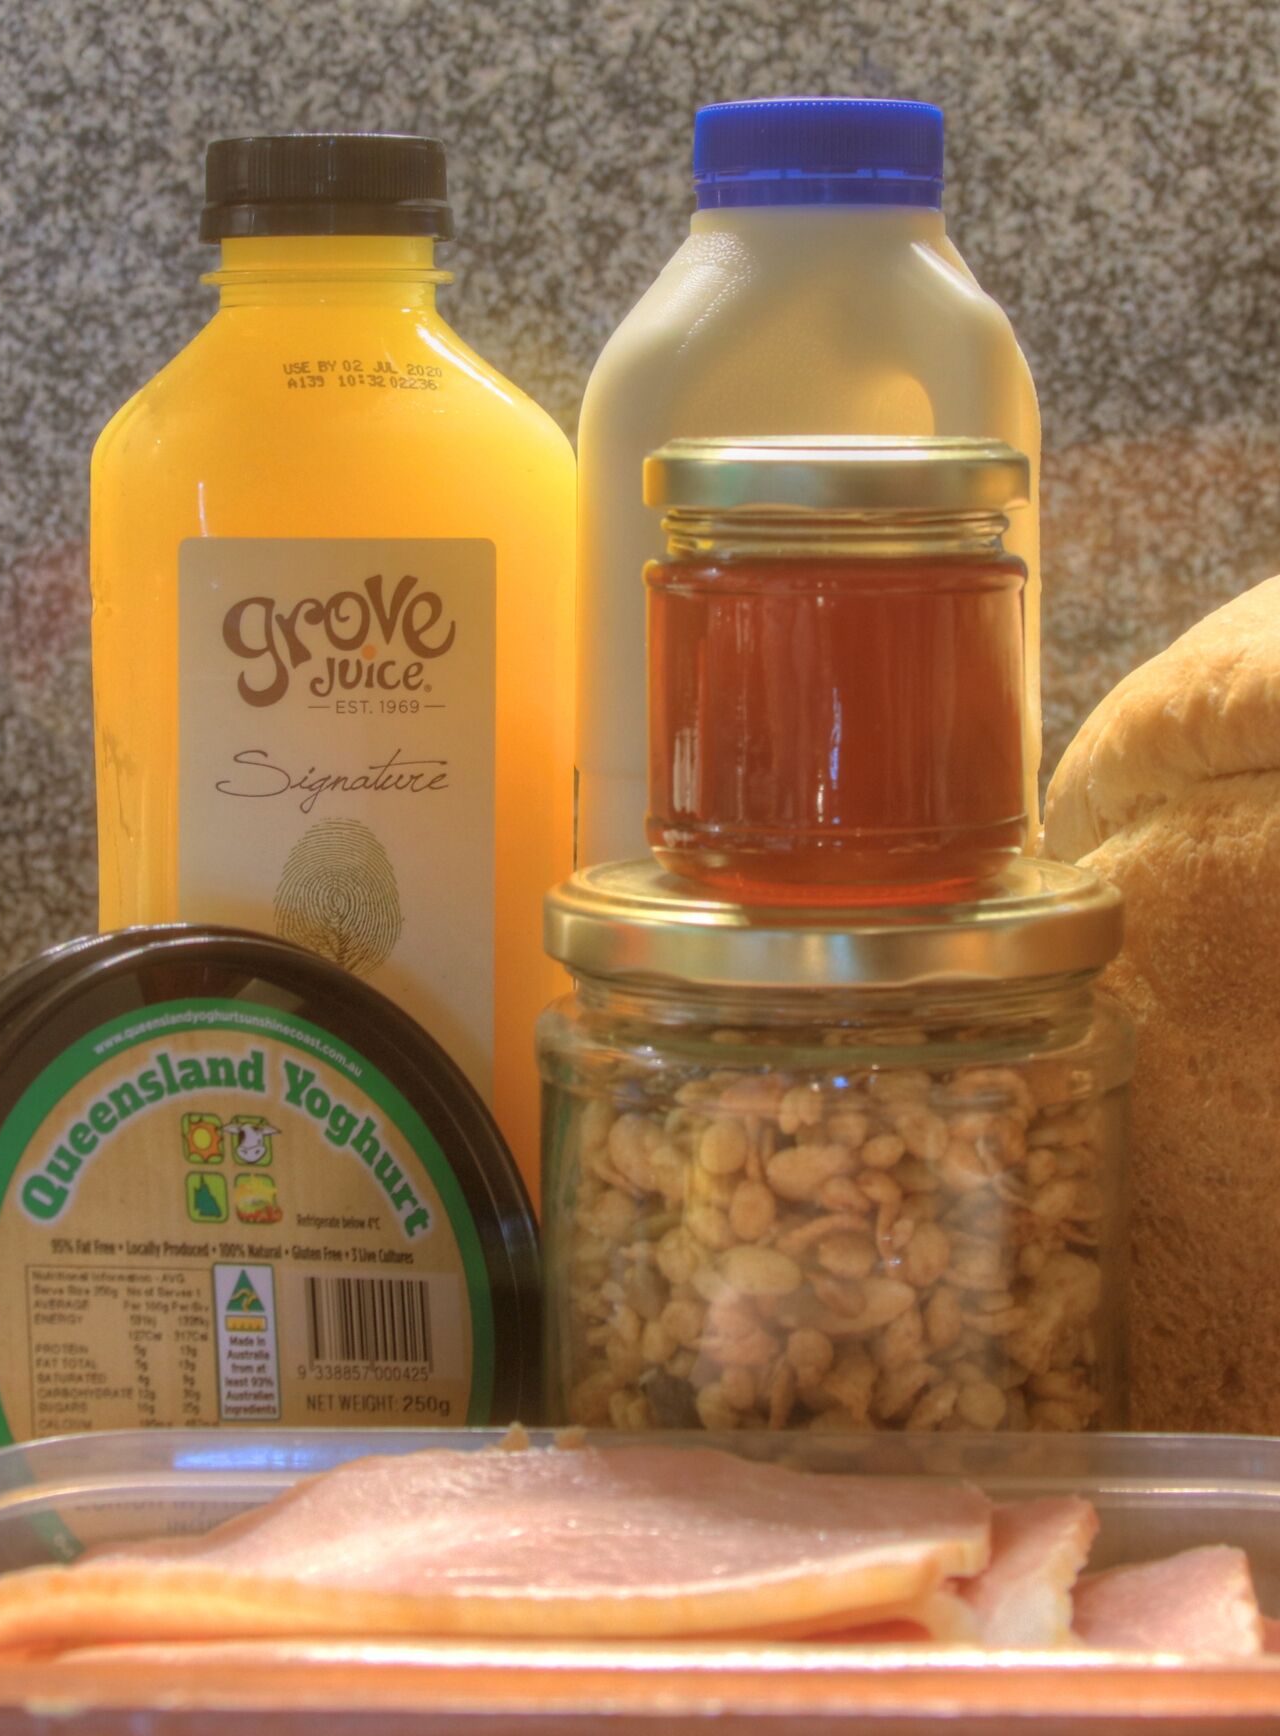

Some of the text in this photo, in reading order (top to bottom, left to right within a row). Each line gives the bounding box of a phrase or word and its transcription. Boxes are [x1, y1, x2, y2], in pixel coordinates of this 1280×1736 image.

[282, 359, 443, 378] USE BY 02 JUL 2020
[287, 375, 325, 389] A139
[338, 374, 387, 388] 10:32
[222, 573, 456, 708] grove
[335, 699, 420, 714] EST. 1969
[215, 748, 449, 814] Signature
[93, 1009, 363, 1078] www.queenslandyoghurtsunshinecoast.com.au
[21, 1050, 430, 1238] Queensland Yoghurt
[296, 1214, 340, 1230] Refrigerate
[341, 1215, 366, 1230] below
[75, 1239, 91, 1254] Fat
[94, 1239, 115, 1255] Free
[126, 1240, 160, 1258] Locally
[162, 1241, 209, 1257] Produced
[218, 1242, 244, 1258] 100%
[247, 1244, 282, 1259] Natural
[292, 1245, 321, 1260] Gluten
[323, 1246, 343, 1261] Free
[359, 1247, 377, 1263] Live
[378, 1248, 414, 1264] Cultures
[229, 1335, 266, 1347] Made in
[227, 1349, 270, 1360] Australia
[231, 1362, 266, 1374] from at
[297, 1365, 429, 1382] 9 338857 000425
[224, 1376, 248, 1388] least
[226, 1390, 274, 1401] Australian
[306, 1395, 450, 1416] NET WEIGHT: 250g
